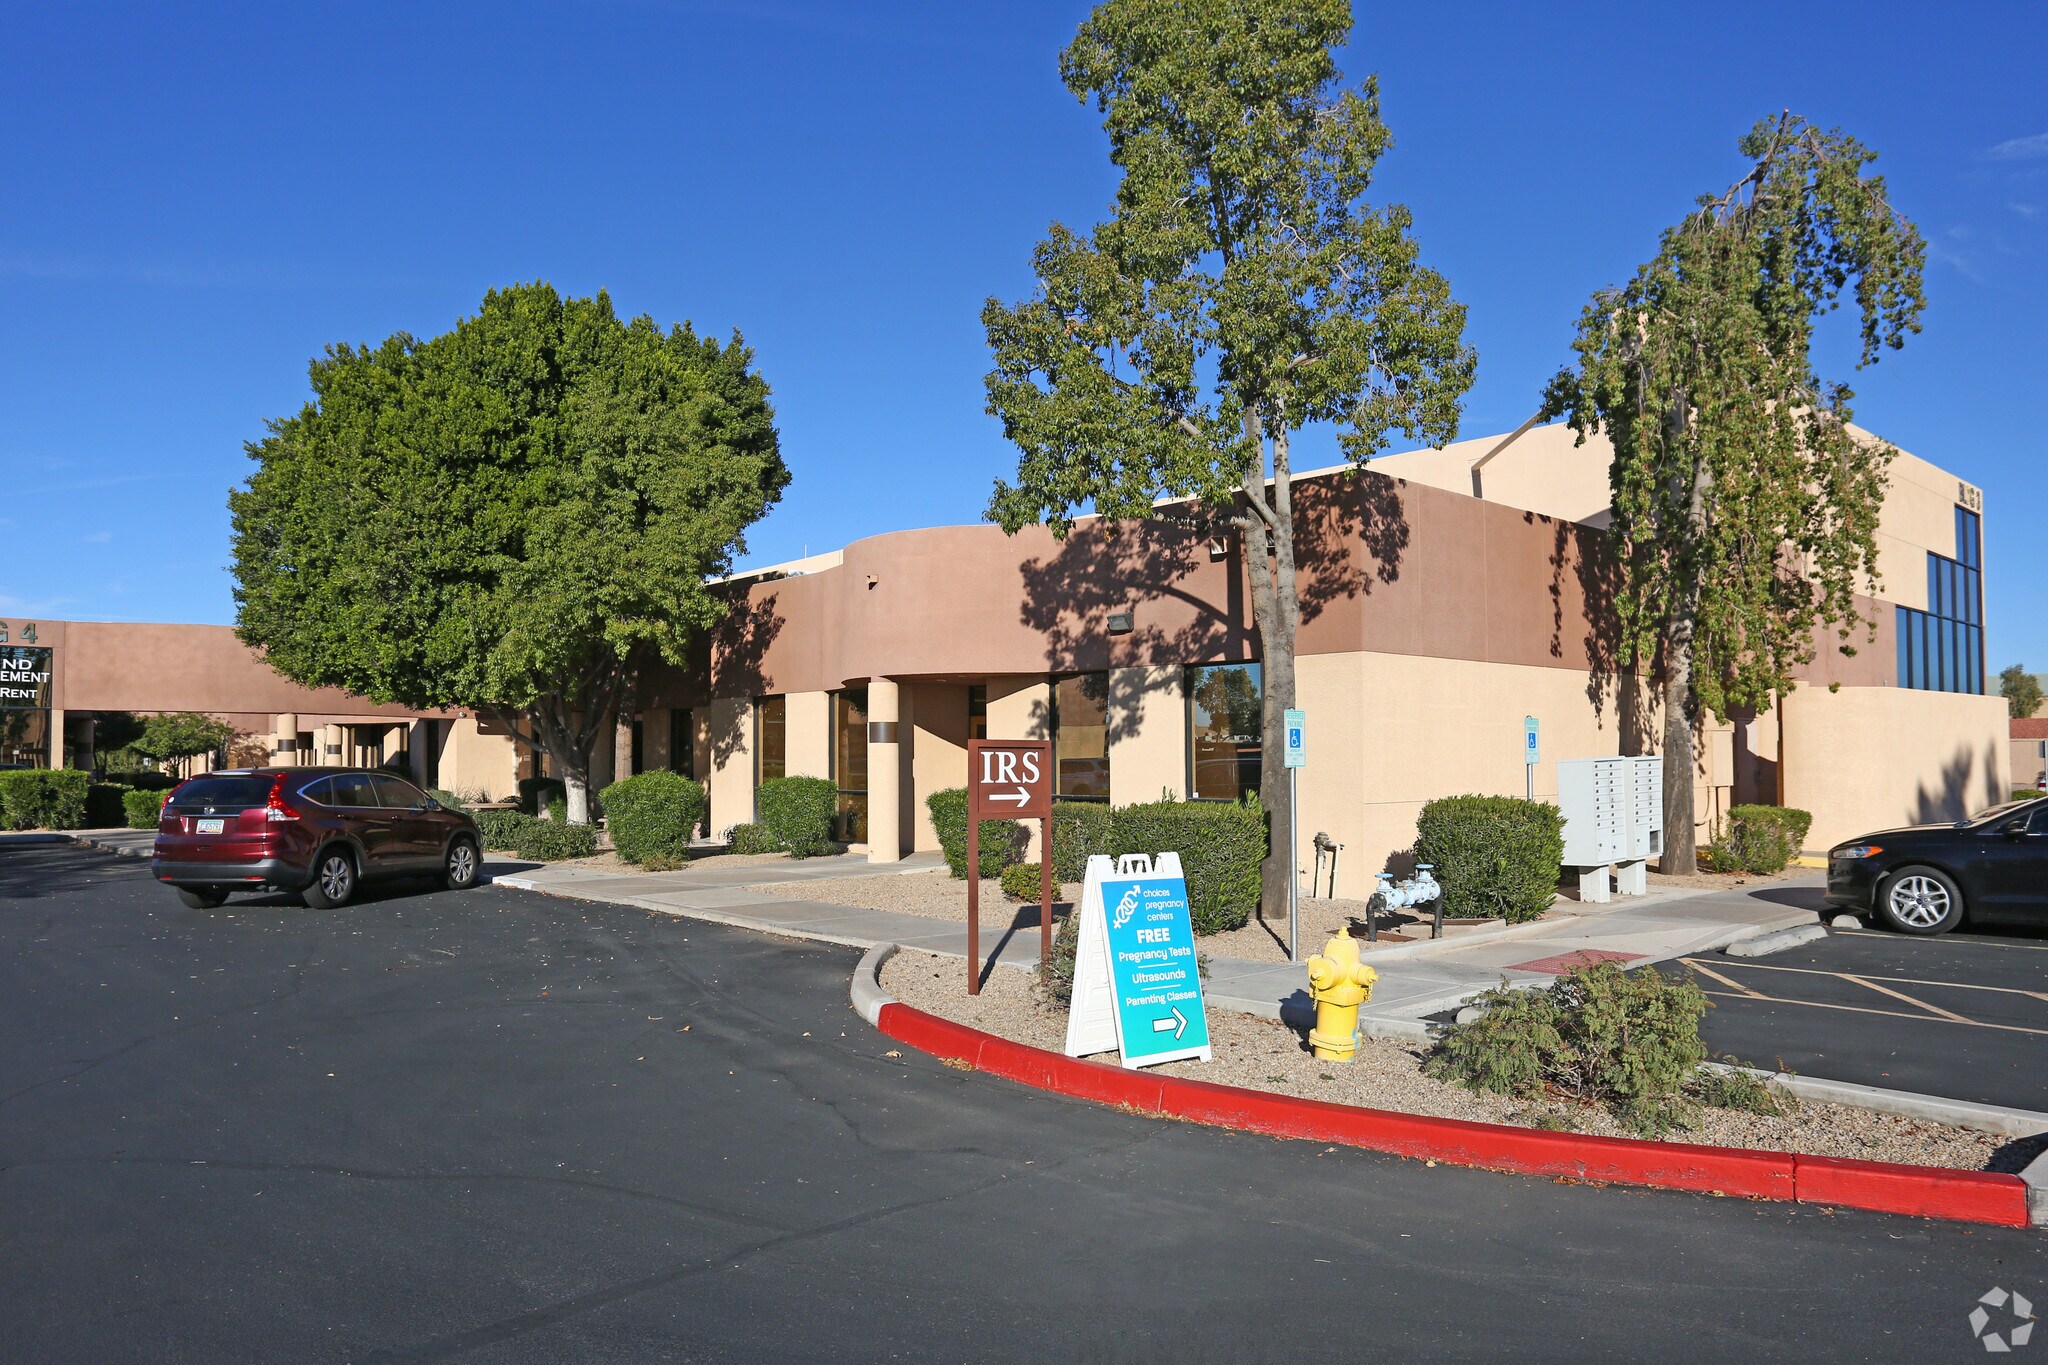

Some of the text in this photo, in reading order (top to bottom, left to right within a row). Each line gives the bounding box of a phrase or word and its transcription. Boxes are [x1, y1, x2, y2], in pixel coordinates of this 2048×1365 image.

[20, 623, 38, 644] 4
[980, 751, 1040, 784] IRS
[1143, 889, 1170, 898] choices
[1145, 900, 1184, 911] pregnancy
[1147, 912, 1174, 922] centers
[1136, 927, 1171, 944] FREE
[1118, 946, 1191, 963] Pregnancy Tests
[1132, 968, 1186, 984] Ultrasounds
[1126, 991, 1197, 1006] Parenting Classes
